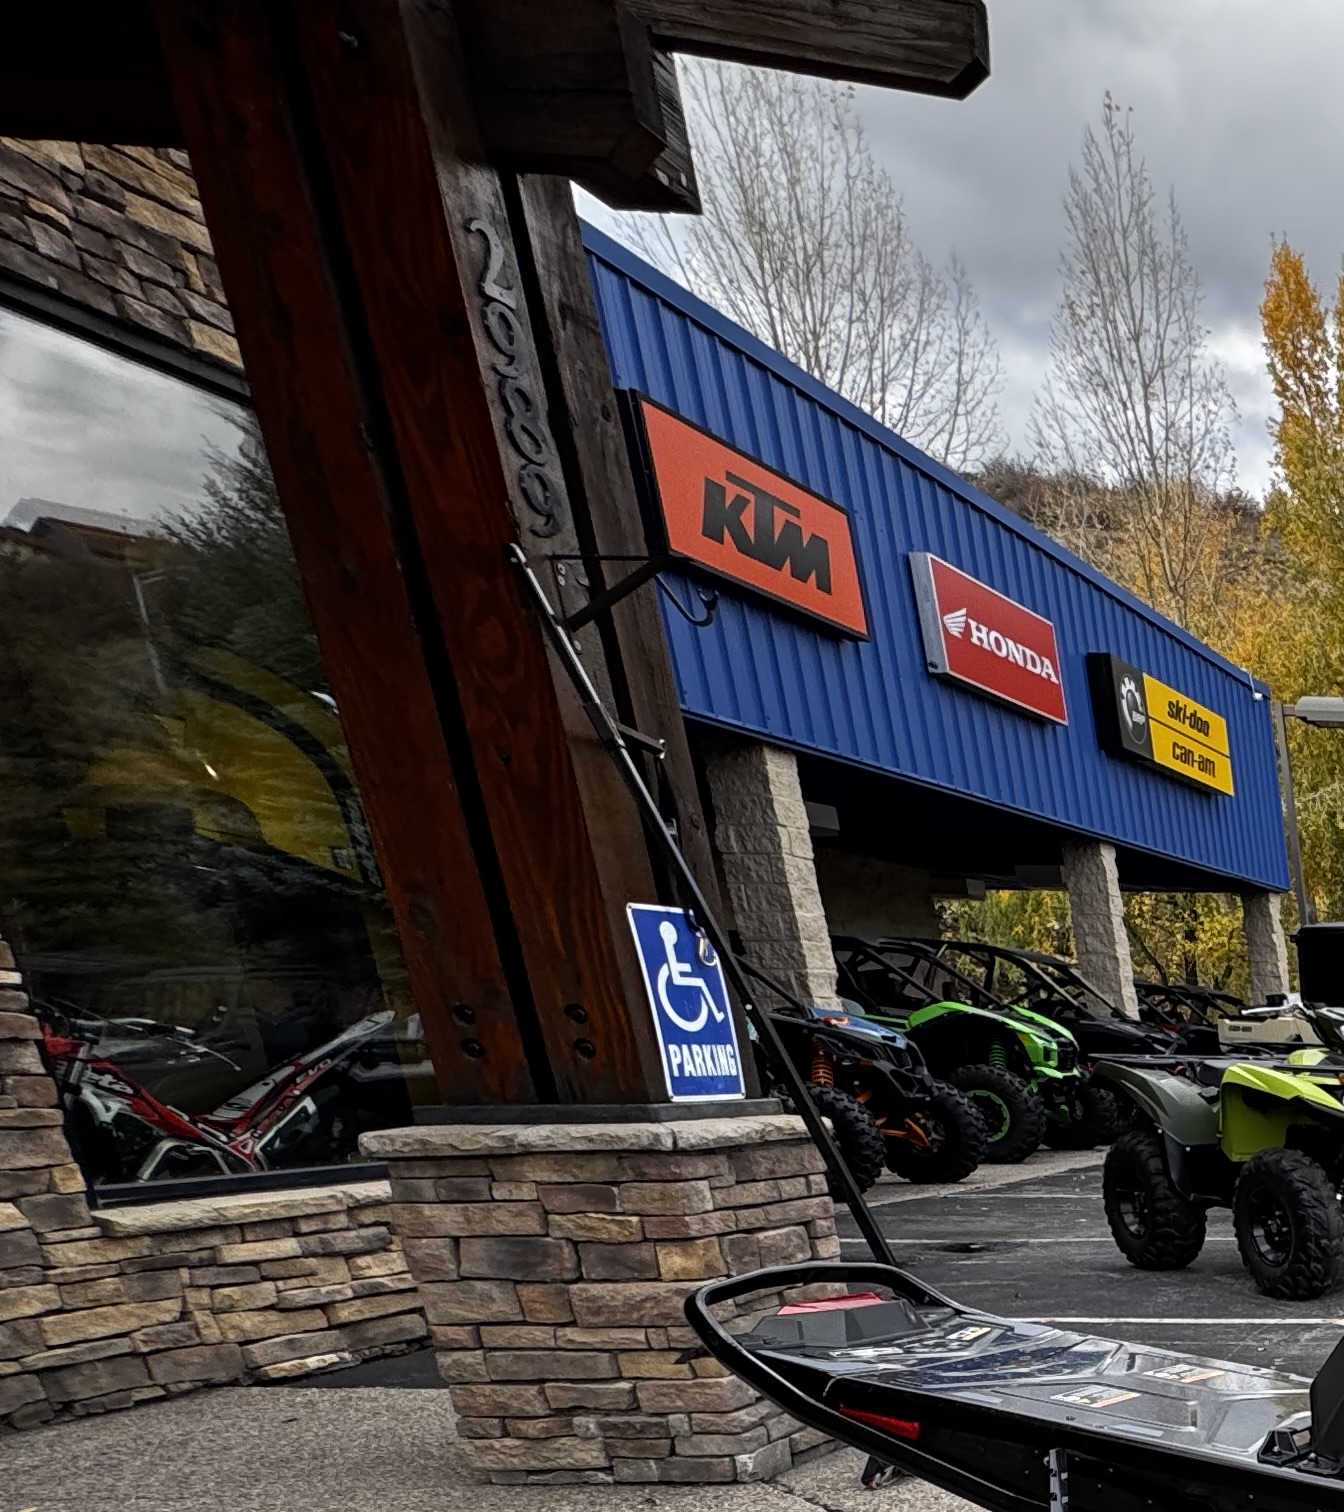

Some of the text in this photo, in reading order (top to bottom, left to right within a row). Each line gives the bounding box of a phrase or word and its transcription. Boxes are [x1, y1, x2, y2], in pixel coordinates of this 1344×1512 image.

[468, 217, 561, 538] 2989
[702, 471, 832, 596] KTM
[967, 618, 1060, 684] HONDA
[1166, 700, 1210, 738] ski-doo
[1171, 740, 1217, 778] can-am
[667, 1043, 738, 1077] PARKING
